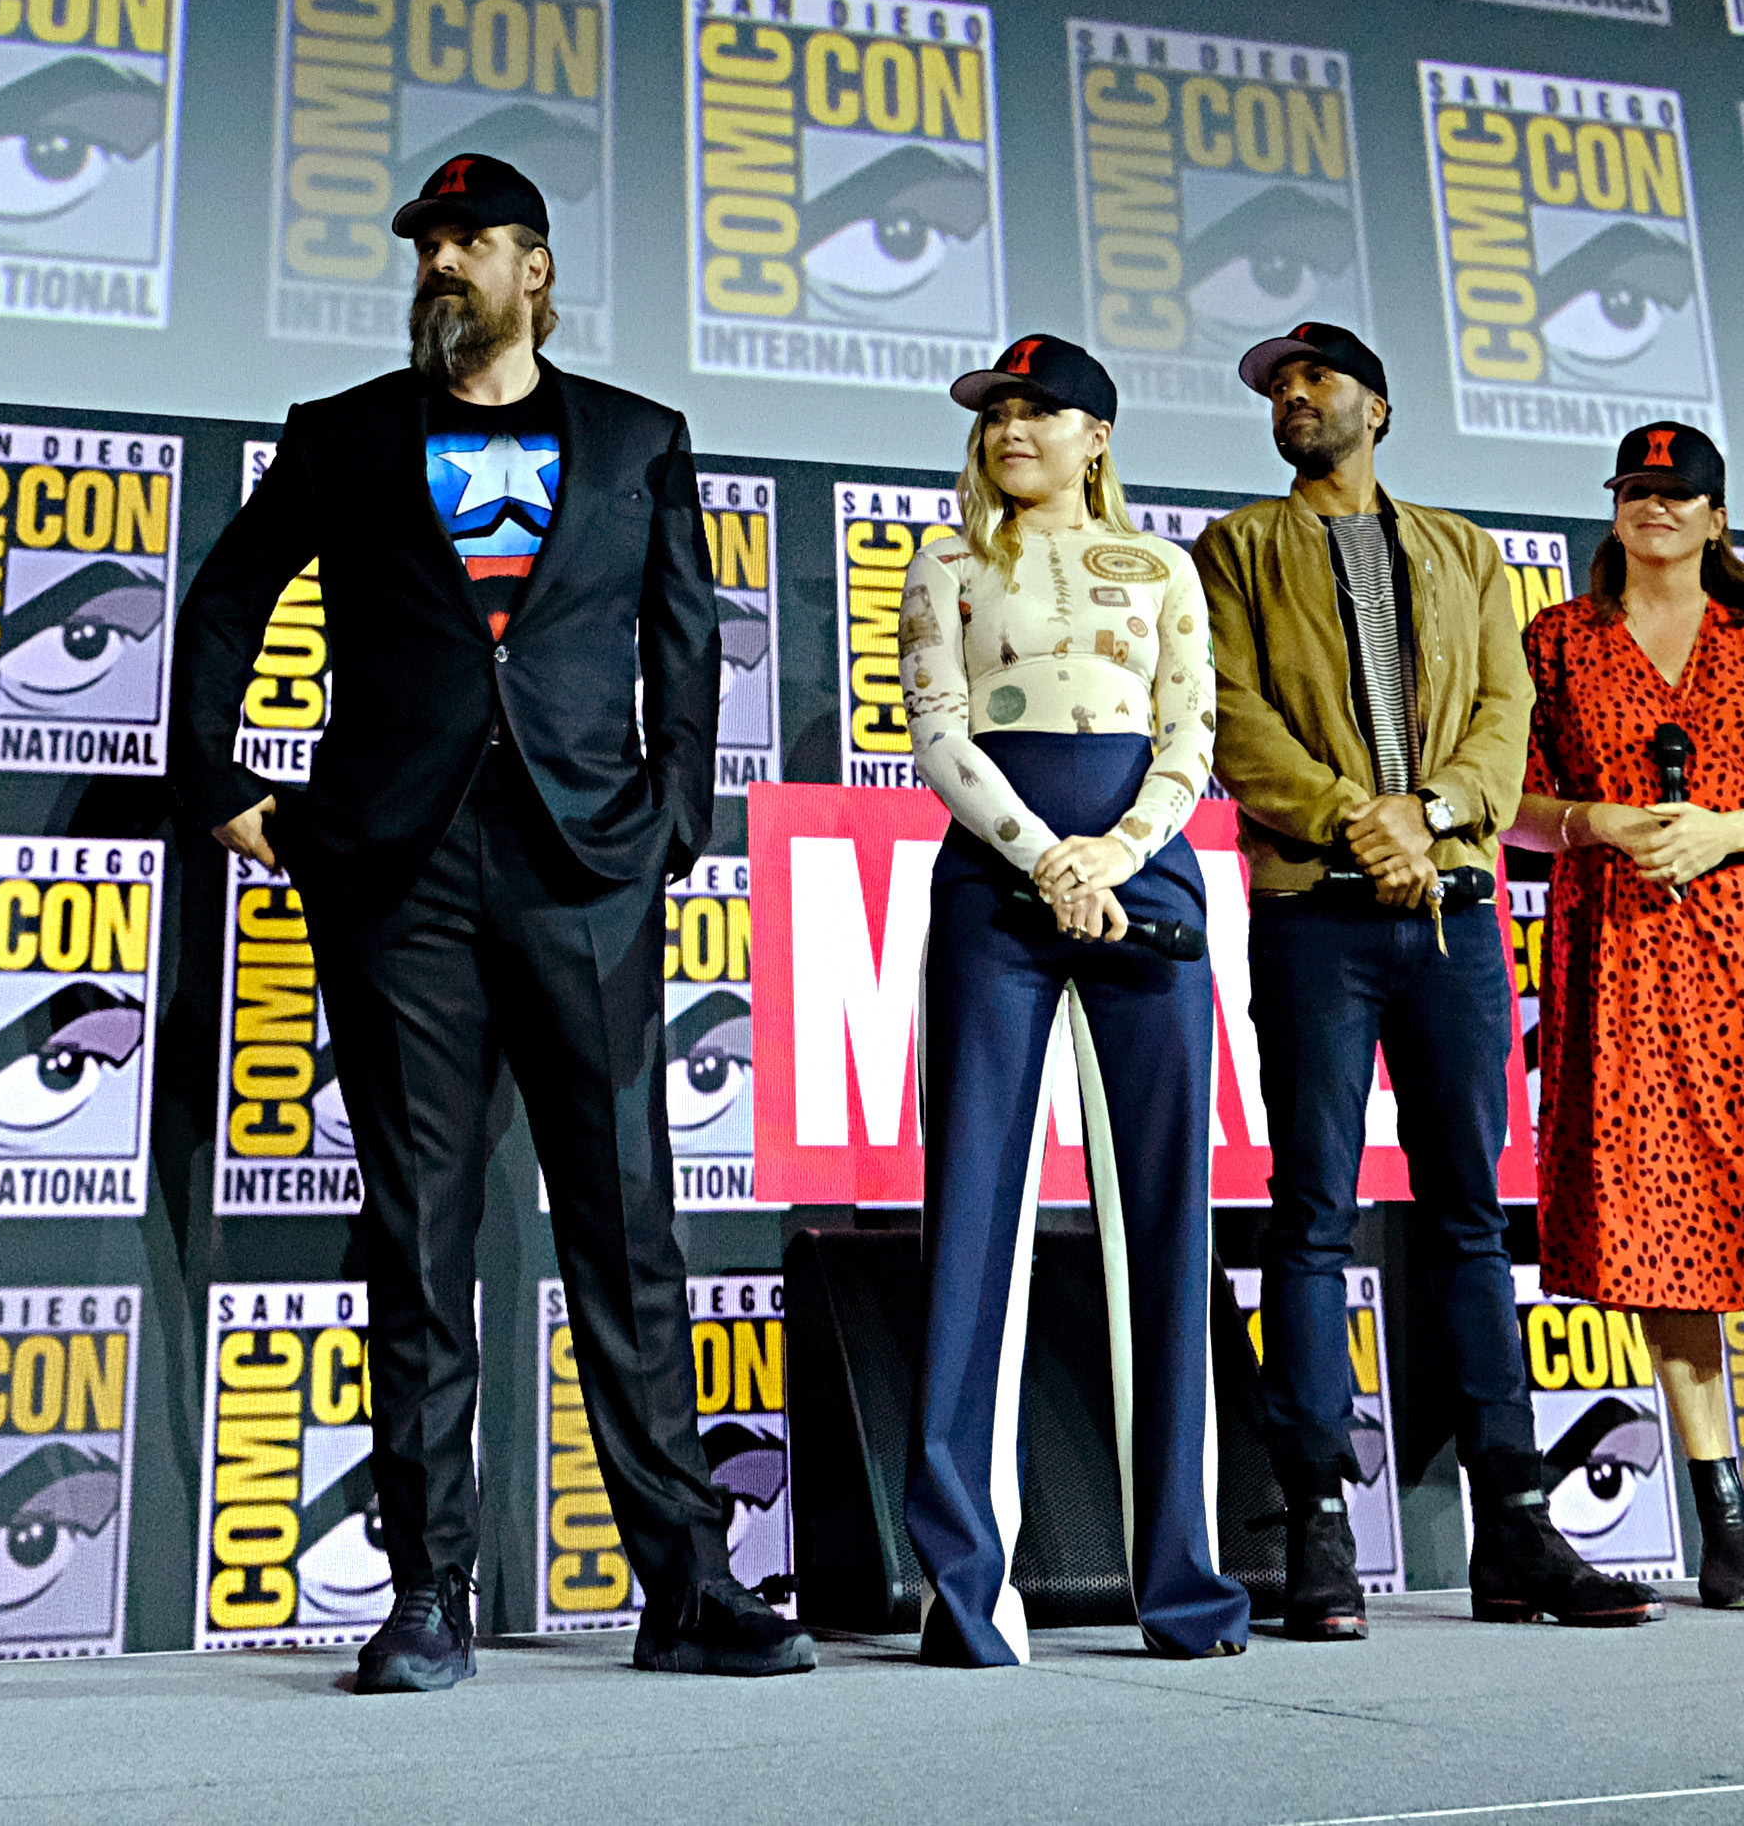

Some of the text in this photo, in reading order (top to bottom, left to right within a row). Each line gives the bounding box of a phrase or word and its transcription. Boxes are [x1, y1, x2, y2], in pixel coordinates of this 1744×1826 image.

[802, 30, 986, 144] CON
[1427, 70, 1675, 126] SAN DIEGO
[697, 20, 803, 320] COMIC
[1524, 115, 1686, 220] CON
[1435, 106, 1546, 385] COMIC
[42, 435, 175, 470] DIEGO
[13, 464, 172, 556] CON
[16, 846, 156, 878] DIEGO
[208, 1329, 306, 1630] COMIC
